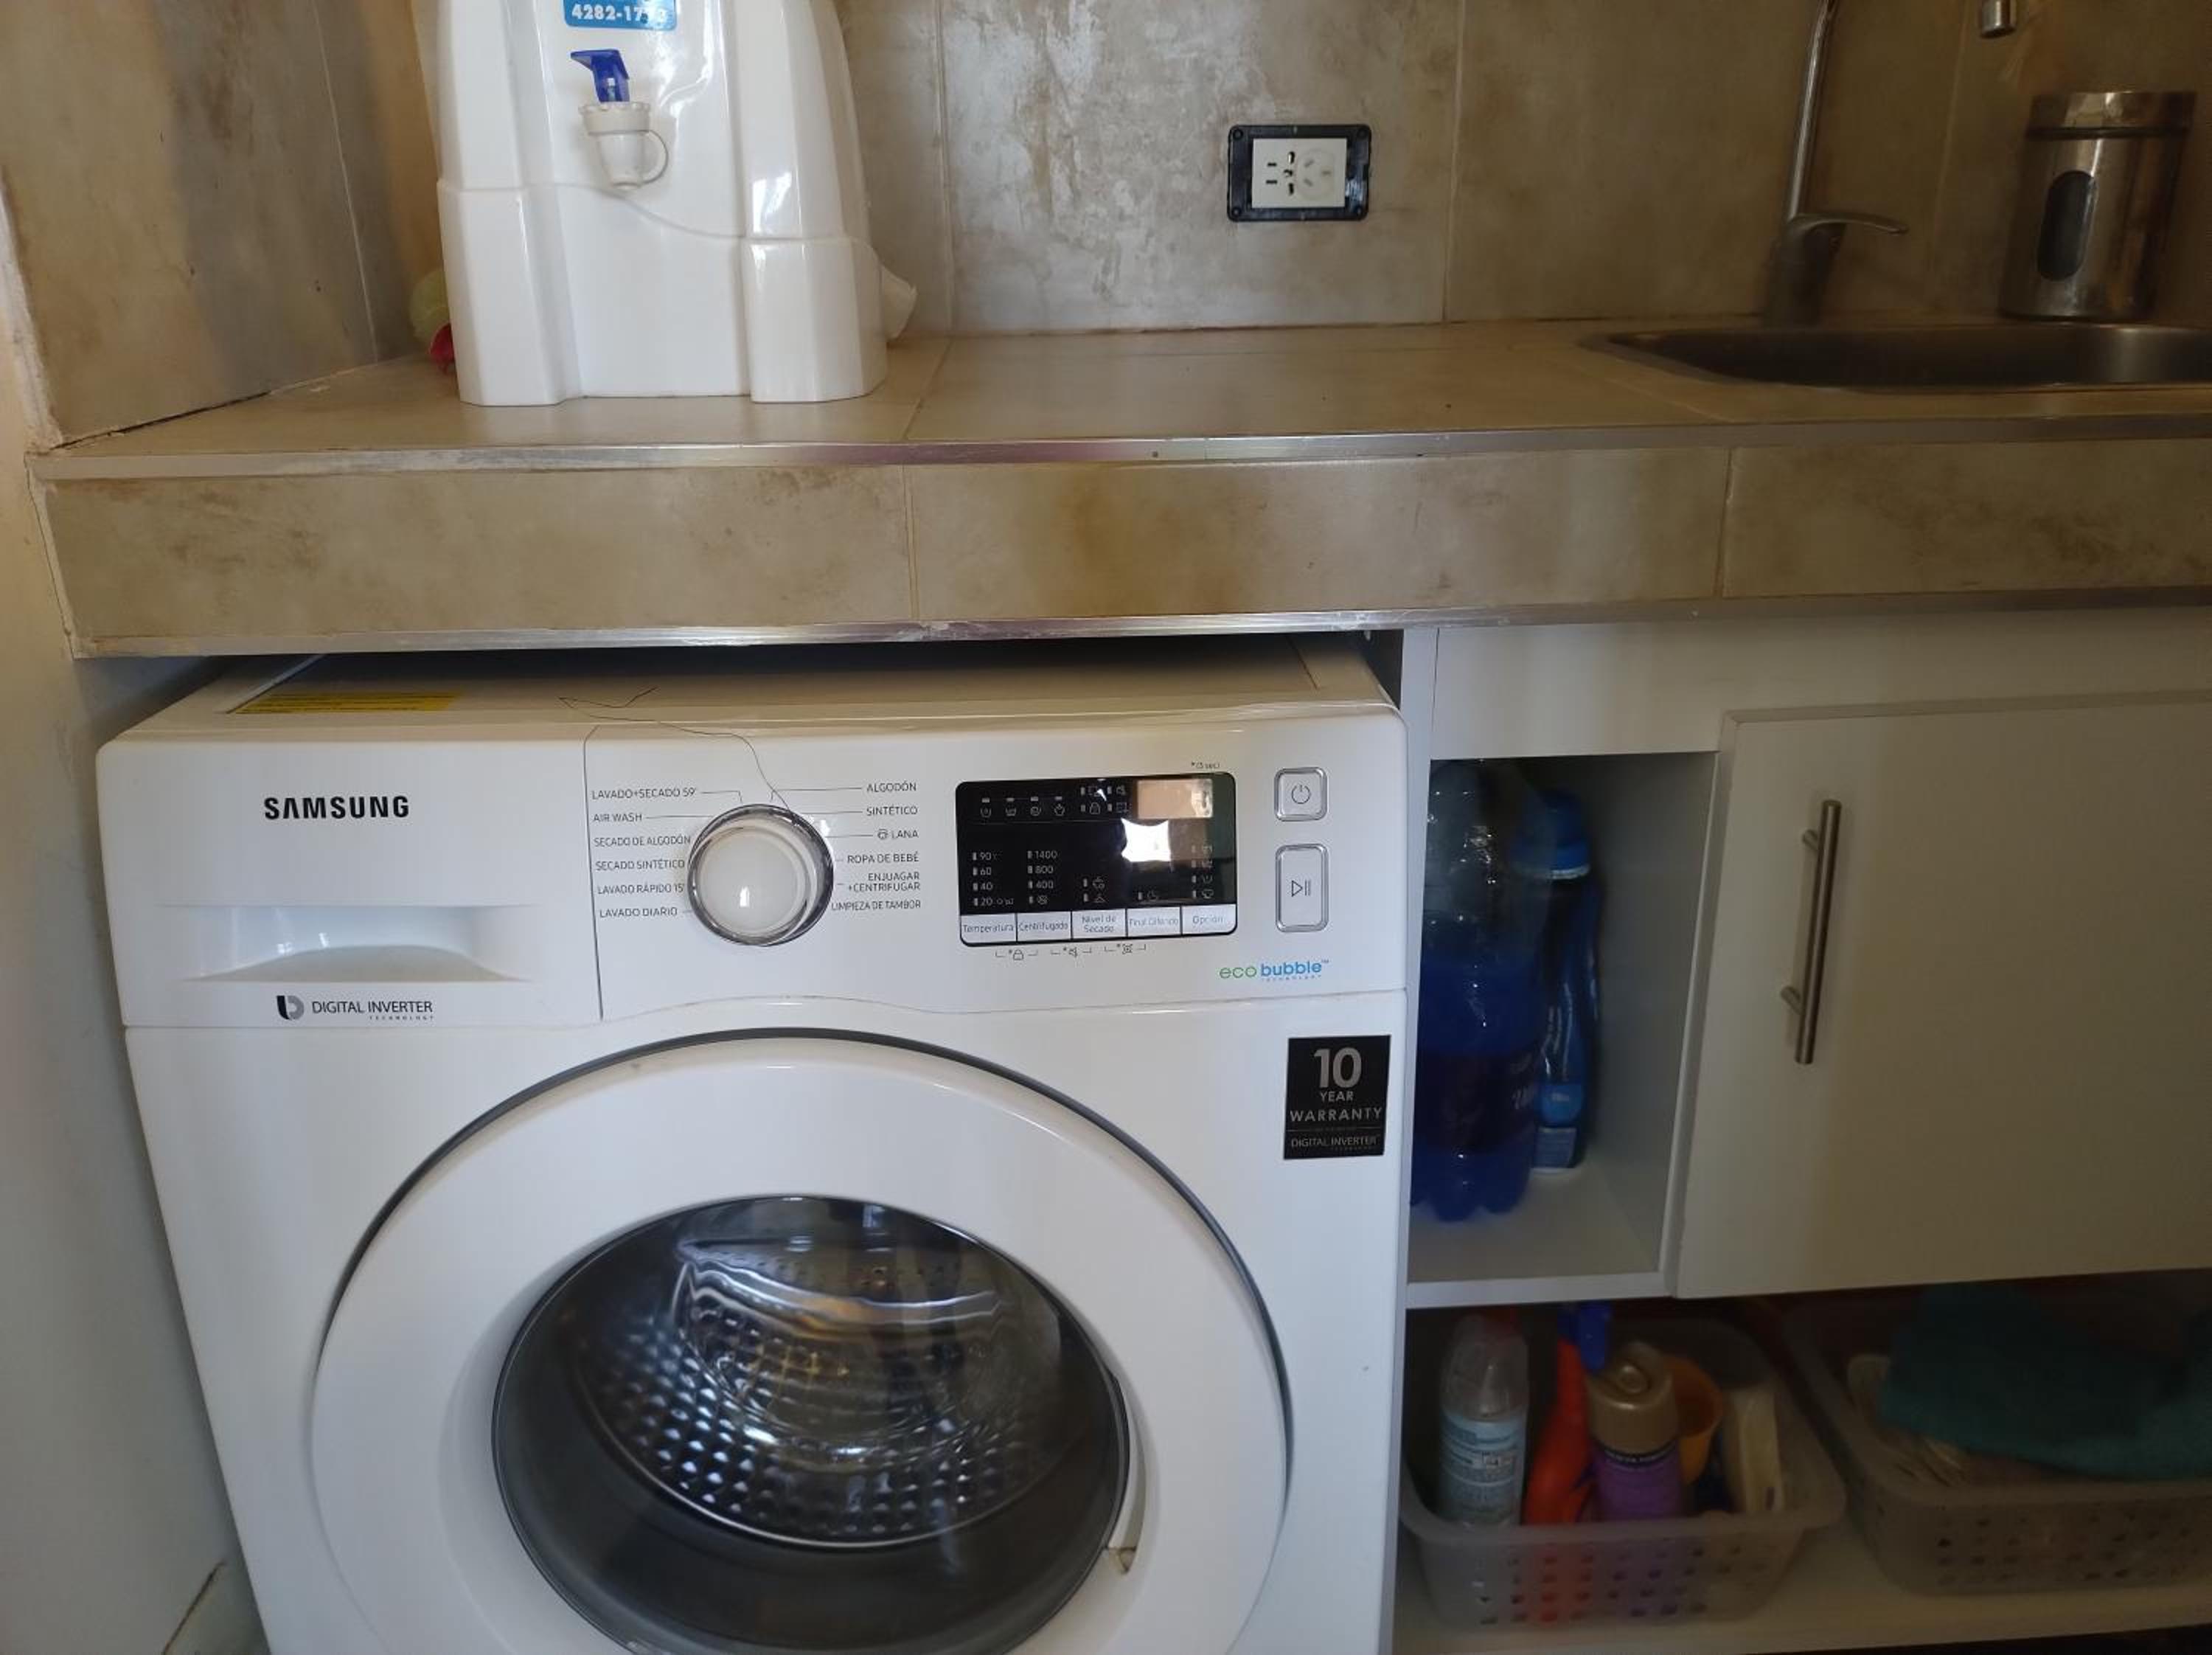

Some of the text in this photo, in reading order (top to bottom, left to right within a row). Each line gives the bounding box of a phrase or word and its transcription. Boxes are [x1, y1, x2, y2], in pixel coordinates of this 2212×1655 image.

[866, 780, 917, 793] ALGODÓN
[591, 788, 681, 800] LAVADO+SECADO
[264, 796, 409, 819] SAMSUNG
[866, 804, 918, 816] SINTÉTICO
[593, 813, 643, 822] AIR WASH
[594, 834, 691, 847] SECADO DE ALGODÓN
[891, 830, 919, 839] LANA
[847, 850, 919, 864] ROPA DE BEBÉ
[1035, 850, 1058, 859] 1400
[595, 858, 685, 871] SECADO SINTÉTICO
[1035, 865, 1054, 874] 800
[868, 871, 919, 881] ENJUAGAR
[980, 867, 992, 875] 60
[598, 884, 635, 895] LAVADO
[636, 881, 672, 894] RÁPIDO
[849, 882, 921, 892] +CENTRIFUGAR
[831, 899, 921, 911] LIMPIEZA DE TAMBOR
[980, 897, 993, 906] 20
[599, 906, 678, 918] LAVADO DIARIO
[963, 923, 1014, 934] Temperatura
[1018, 921, 1068, 932] Centrifugado
[1219, 966, 1257, 979] eco
[1260, 960, 1322, 977] bubble
[311, 1001, 433, 1014] DIGITAL INVERTER
[1314, 1047, 1363, 1089] 10
[1320, 1090, 1354, 1103] YEAR
[1290, 1106, 1382, 1122] WARRANTY
[1291, 1135, 1377, 1148] DIGITAL INVERTER
